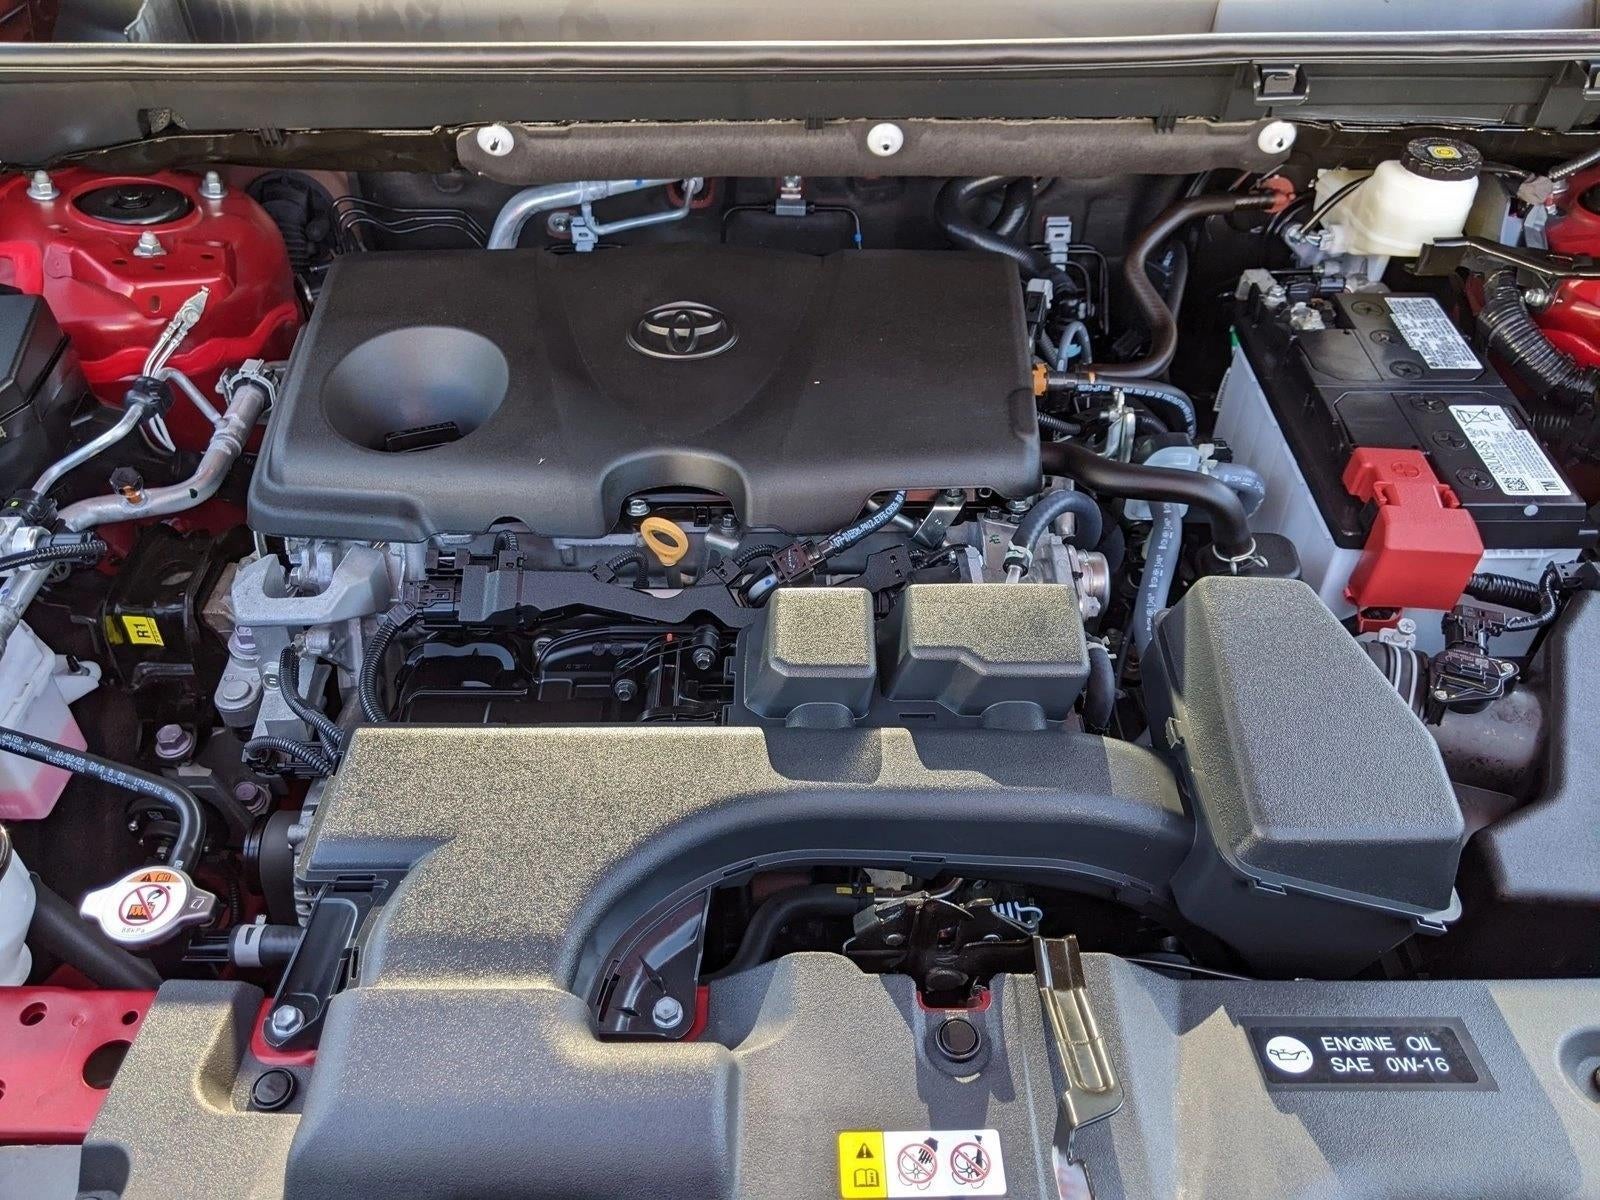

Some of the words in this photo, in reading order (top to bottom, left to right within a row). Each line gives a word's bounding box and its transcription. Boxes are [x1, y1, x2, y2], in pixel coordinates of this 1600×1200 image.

[133, 623, 151, 638] R1
[2, 732, 24, 745] WATER
[1320, 1036, 1396, 1052] ENGINE
[1405, 1036, 1442, 1052] OIL
[1330, 1057, 1374, 1073] SAE
[1385, 1057, 1450, 1073] 0W-16
